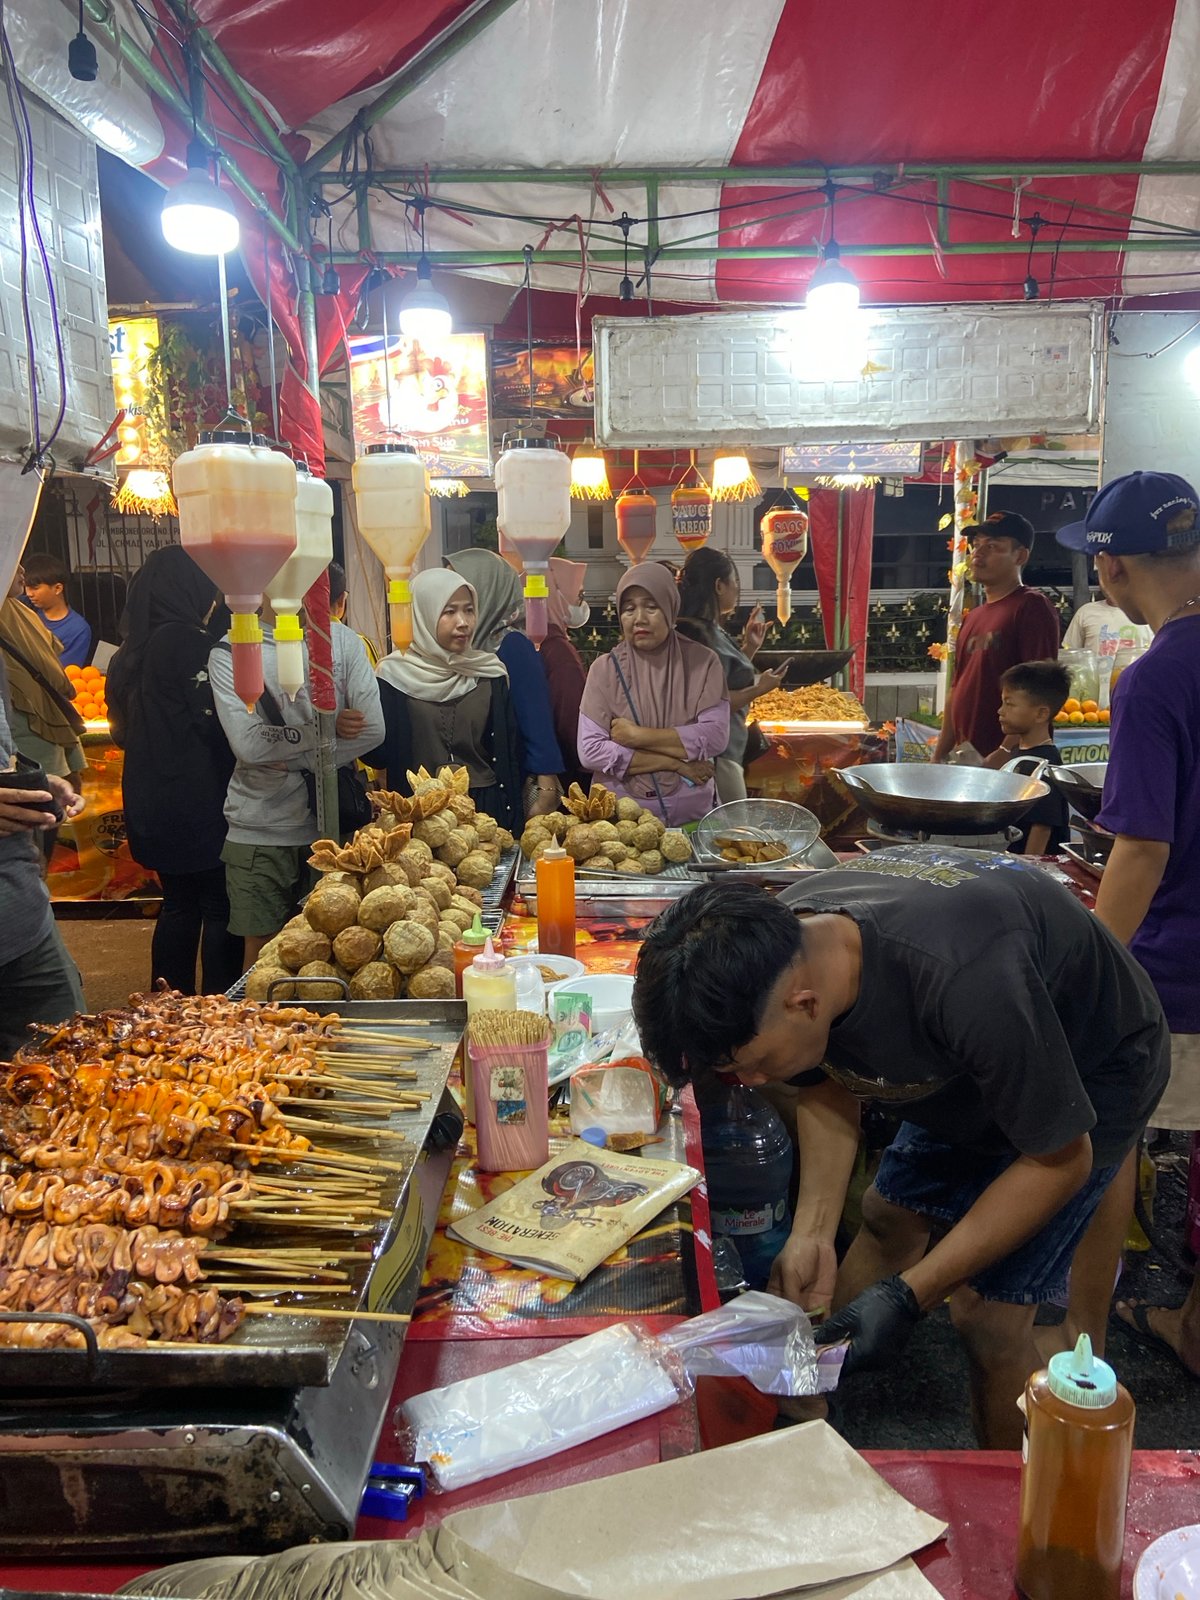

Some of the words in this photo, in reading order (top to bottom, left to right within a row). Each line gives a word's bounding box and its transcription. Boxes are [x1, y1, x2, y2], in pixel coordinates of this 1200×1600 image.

[774, 520, 804, 534] SAOS
[1060, 743, 1110, 765] EMON
[744, 1209, 755, 1219] Le
[484, 1216, 561, 1241] GENERATION
[724, 1217, 766, 1228] Minerale
[475, 1223, 498, 1237] BEST
[498, 1232, 514, 1243] THE
